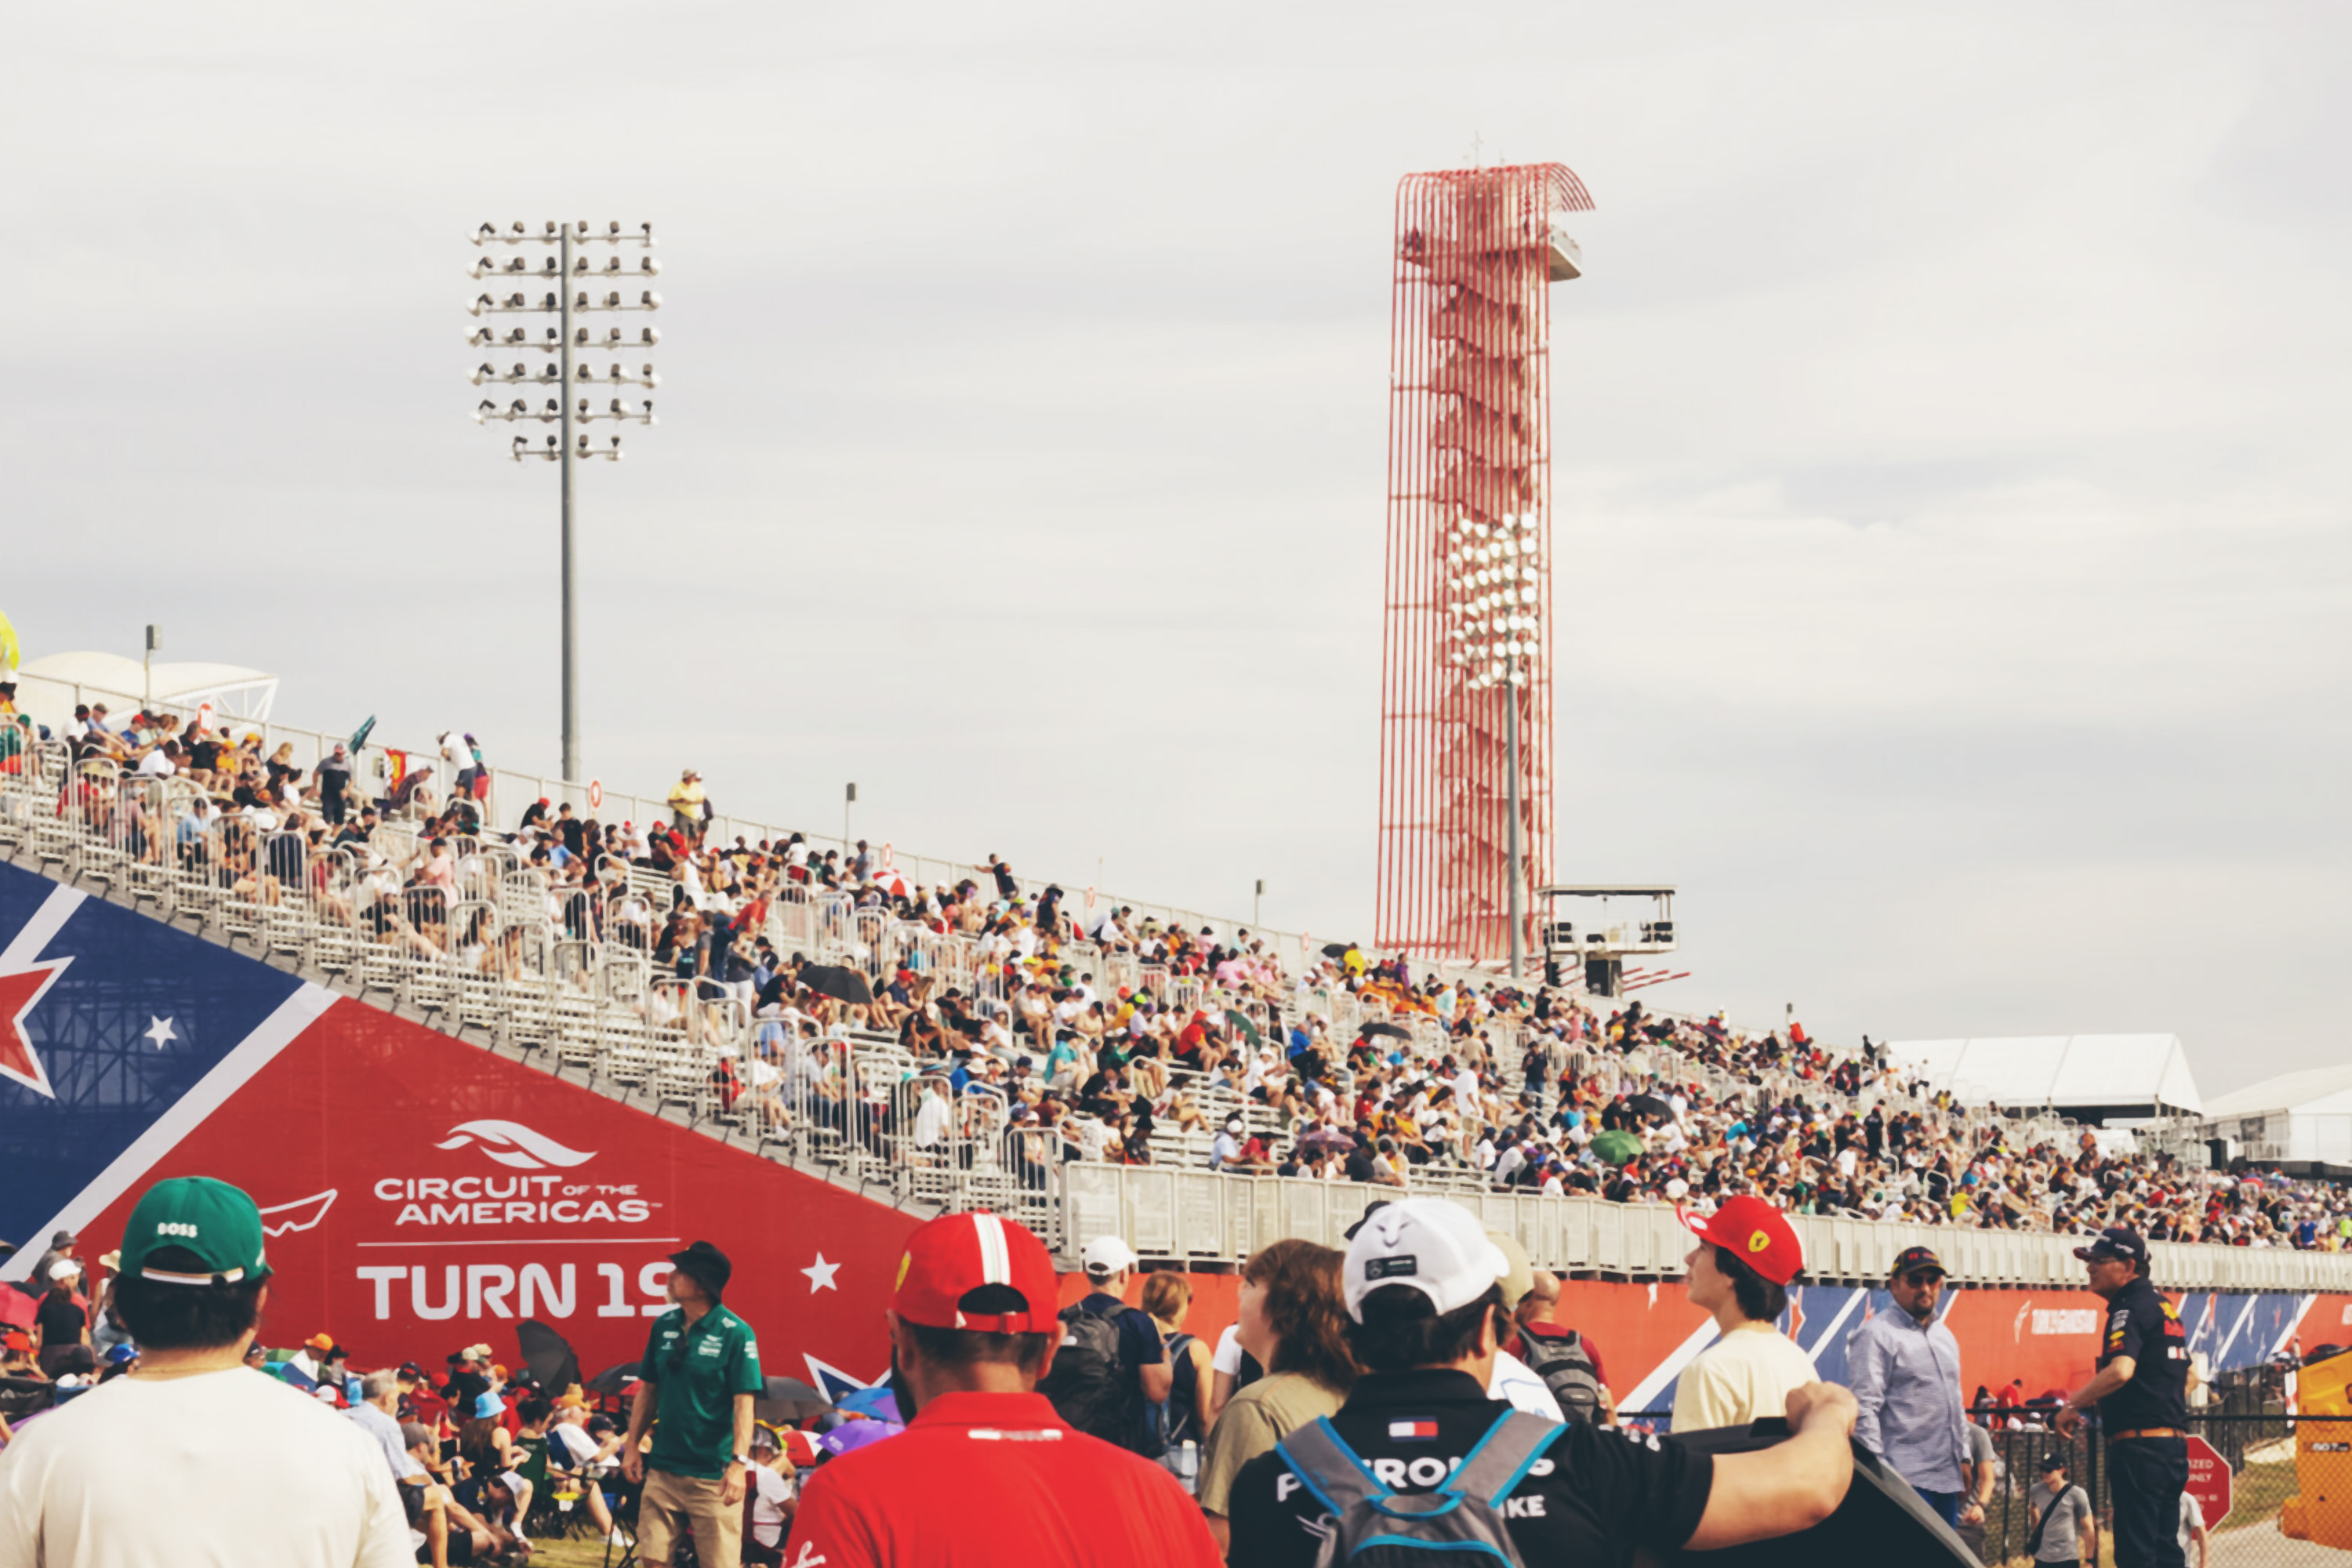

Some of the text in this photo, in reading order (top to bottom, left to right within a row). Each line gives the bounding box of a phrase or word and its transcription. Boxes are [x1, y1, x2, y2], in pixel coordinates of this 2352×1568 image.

[374, 1175, 639, 1201] CIRCUIT OF THE
[394, 1199, 651, 1225] AMERICAS
[157, 1221, 198, 1238] BOSS
[357, 1263, 576, 1320] TURN
